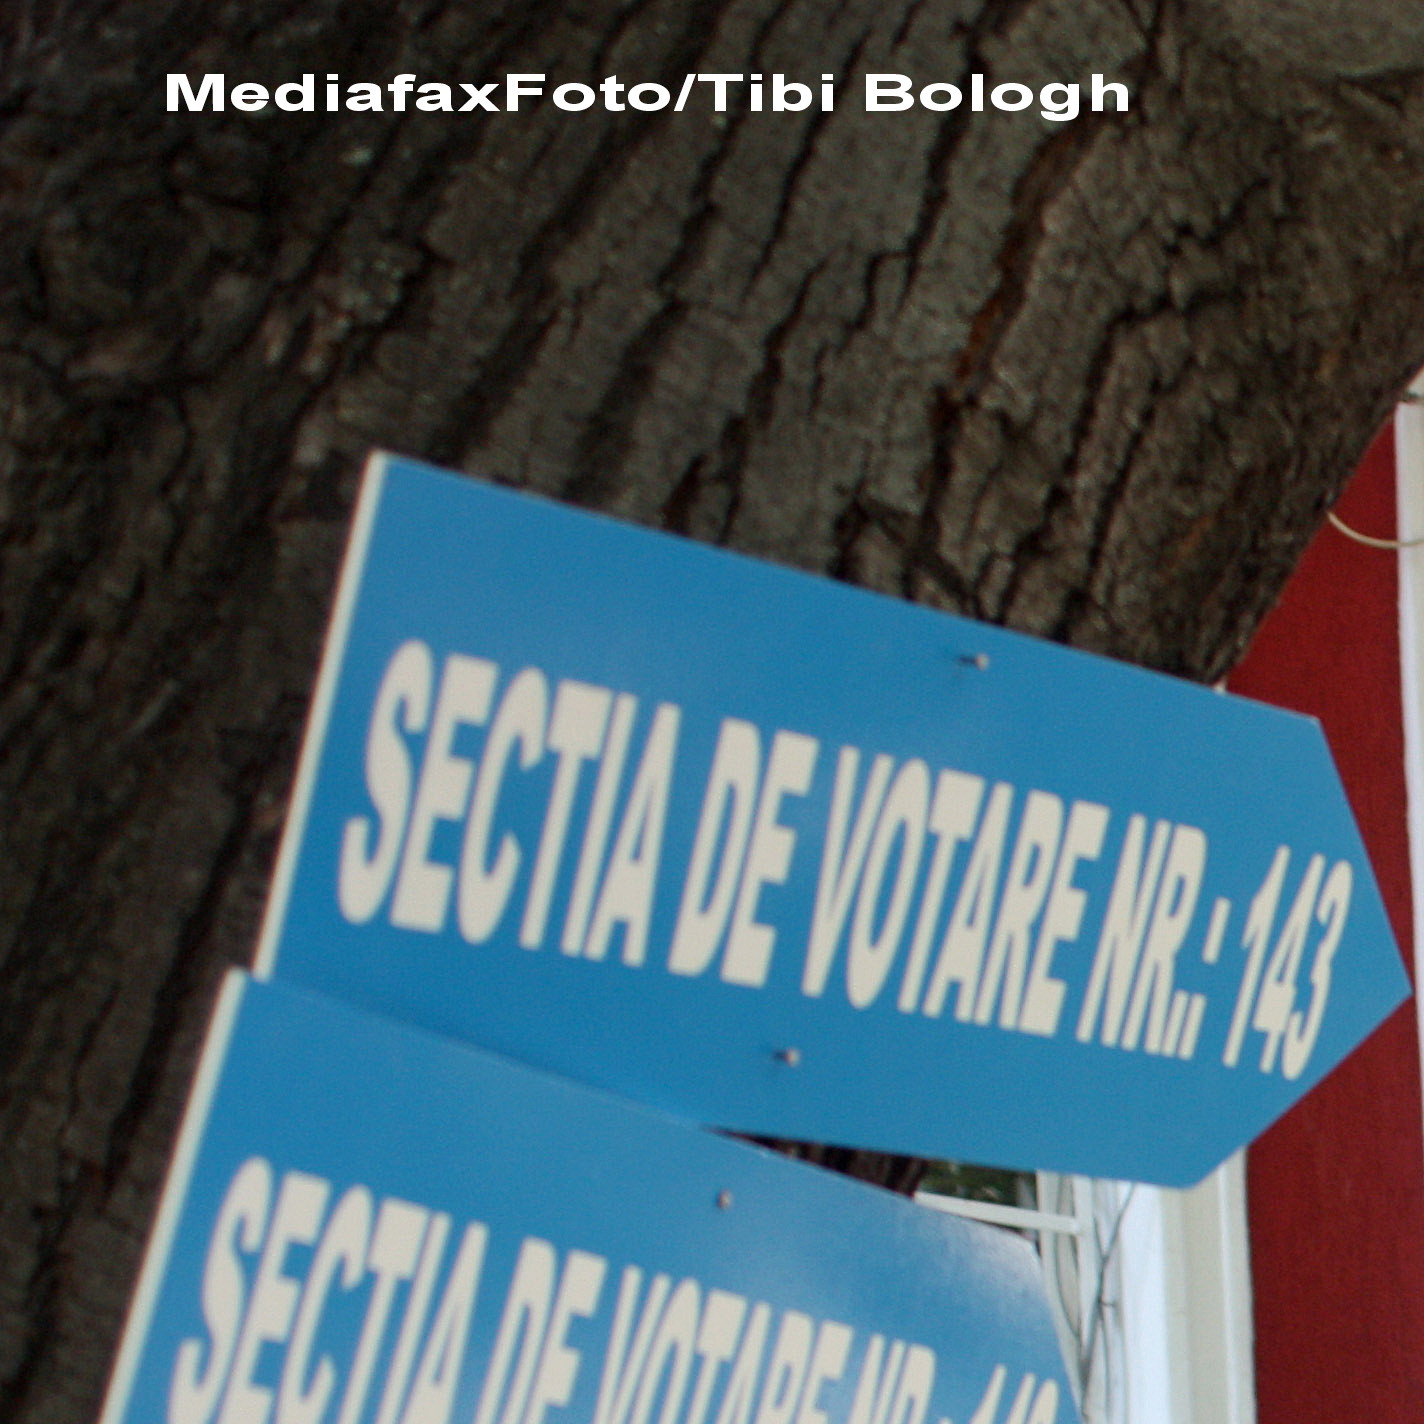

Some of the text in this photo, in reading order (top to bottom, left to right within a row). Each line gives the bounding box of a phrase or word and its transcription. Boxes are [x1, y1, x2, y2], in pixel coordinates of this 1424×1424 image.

[338, 639, 680, 967] SECTIA
[667, 717, 819, 987] DE
[801, 745, 1110, 1036] VOTARE
[1221, 844, 1354, 1081] 143
